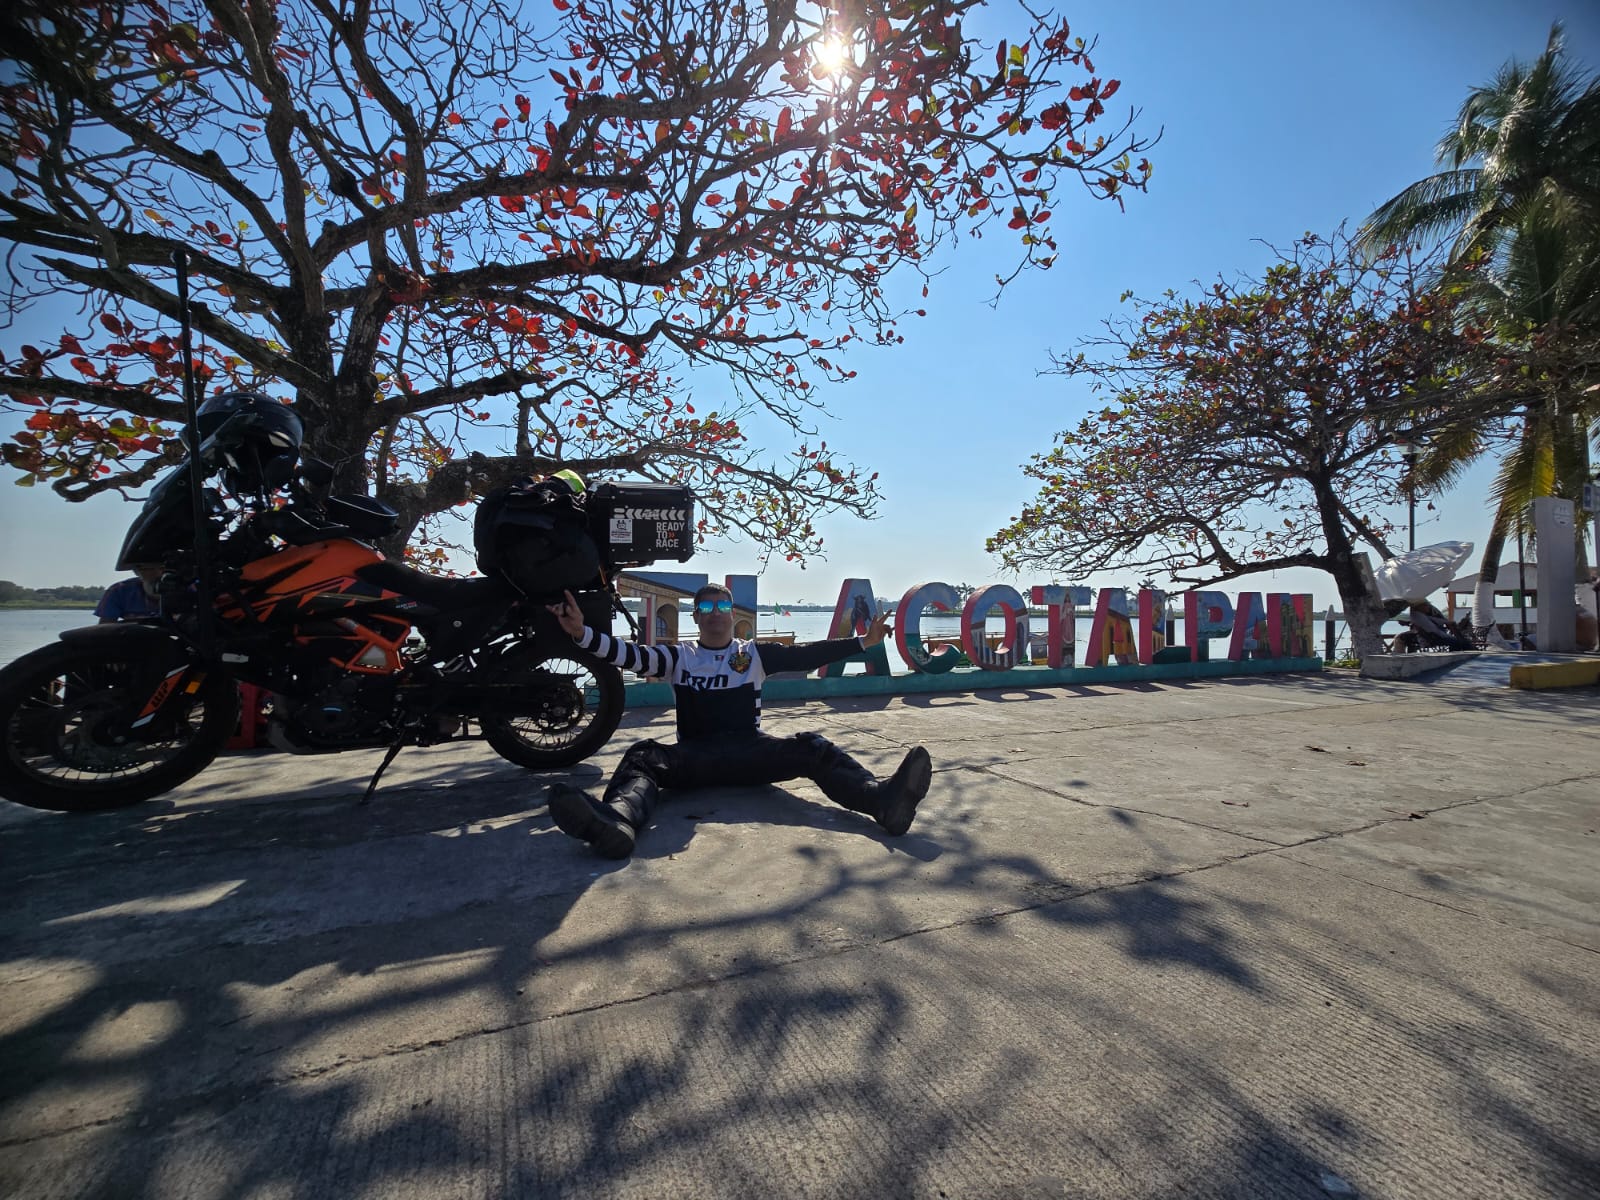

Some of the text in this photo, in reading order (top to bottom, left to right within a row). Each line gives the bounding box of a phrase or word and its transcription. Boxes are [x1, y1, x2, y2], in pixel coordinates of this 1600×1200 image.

[656, 521, 685, 532] READY
[656, 531, 668, 539] TO
[655, 539, 679, 548] RACE
